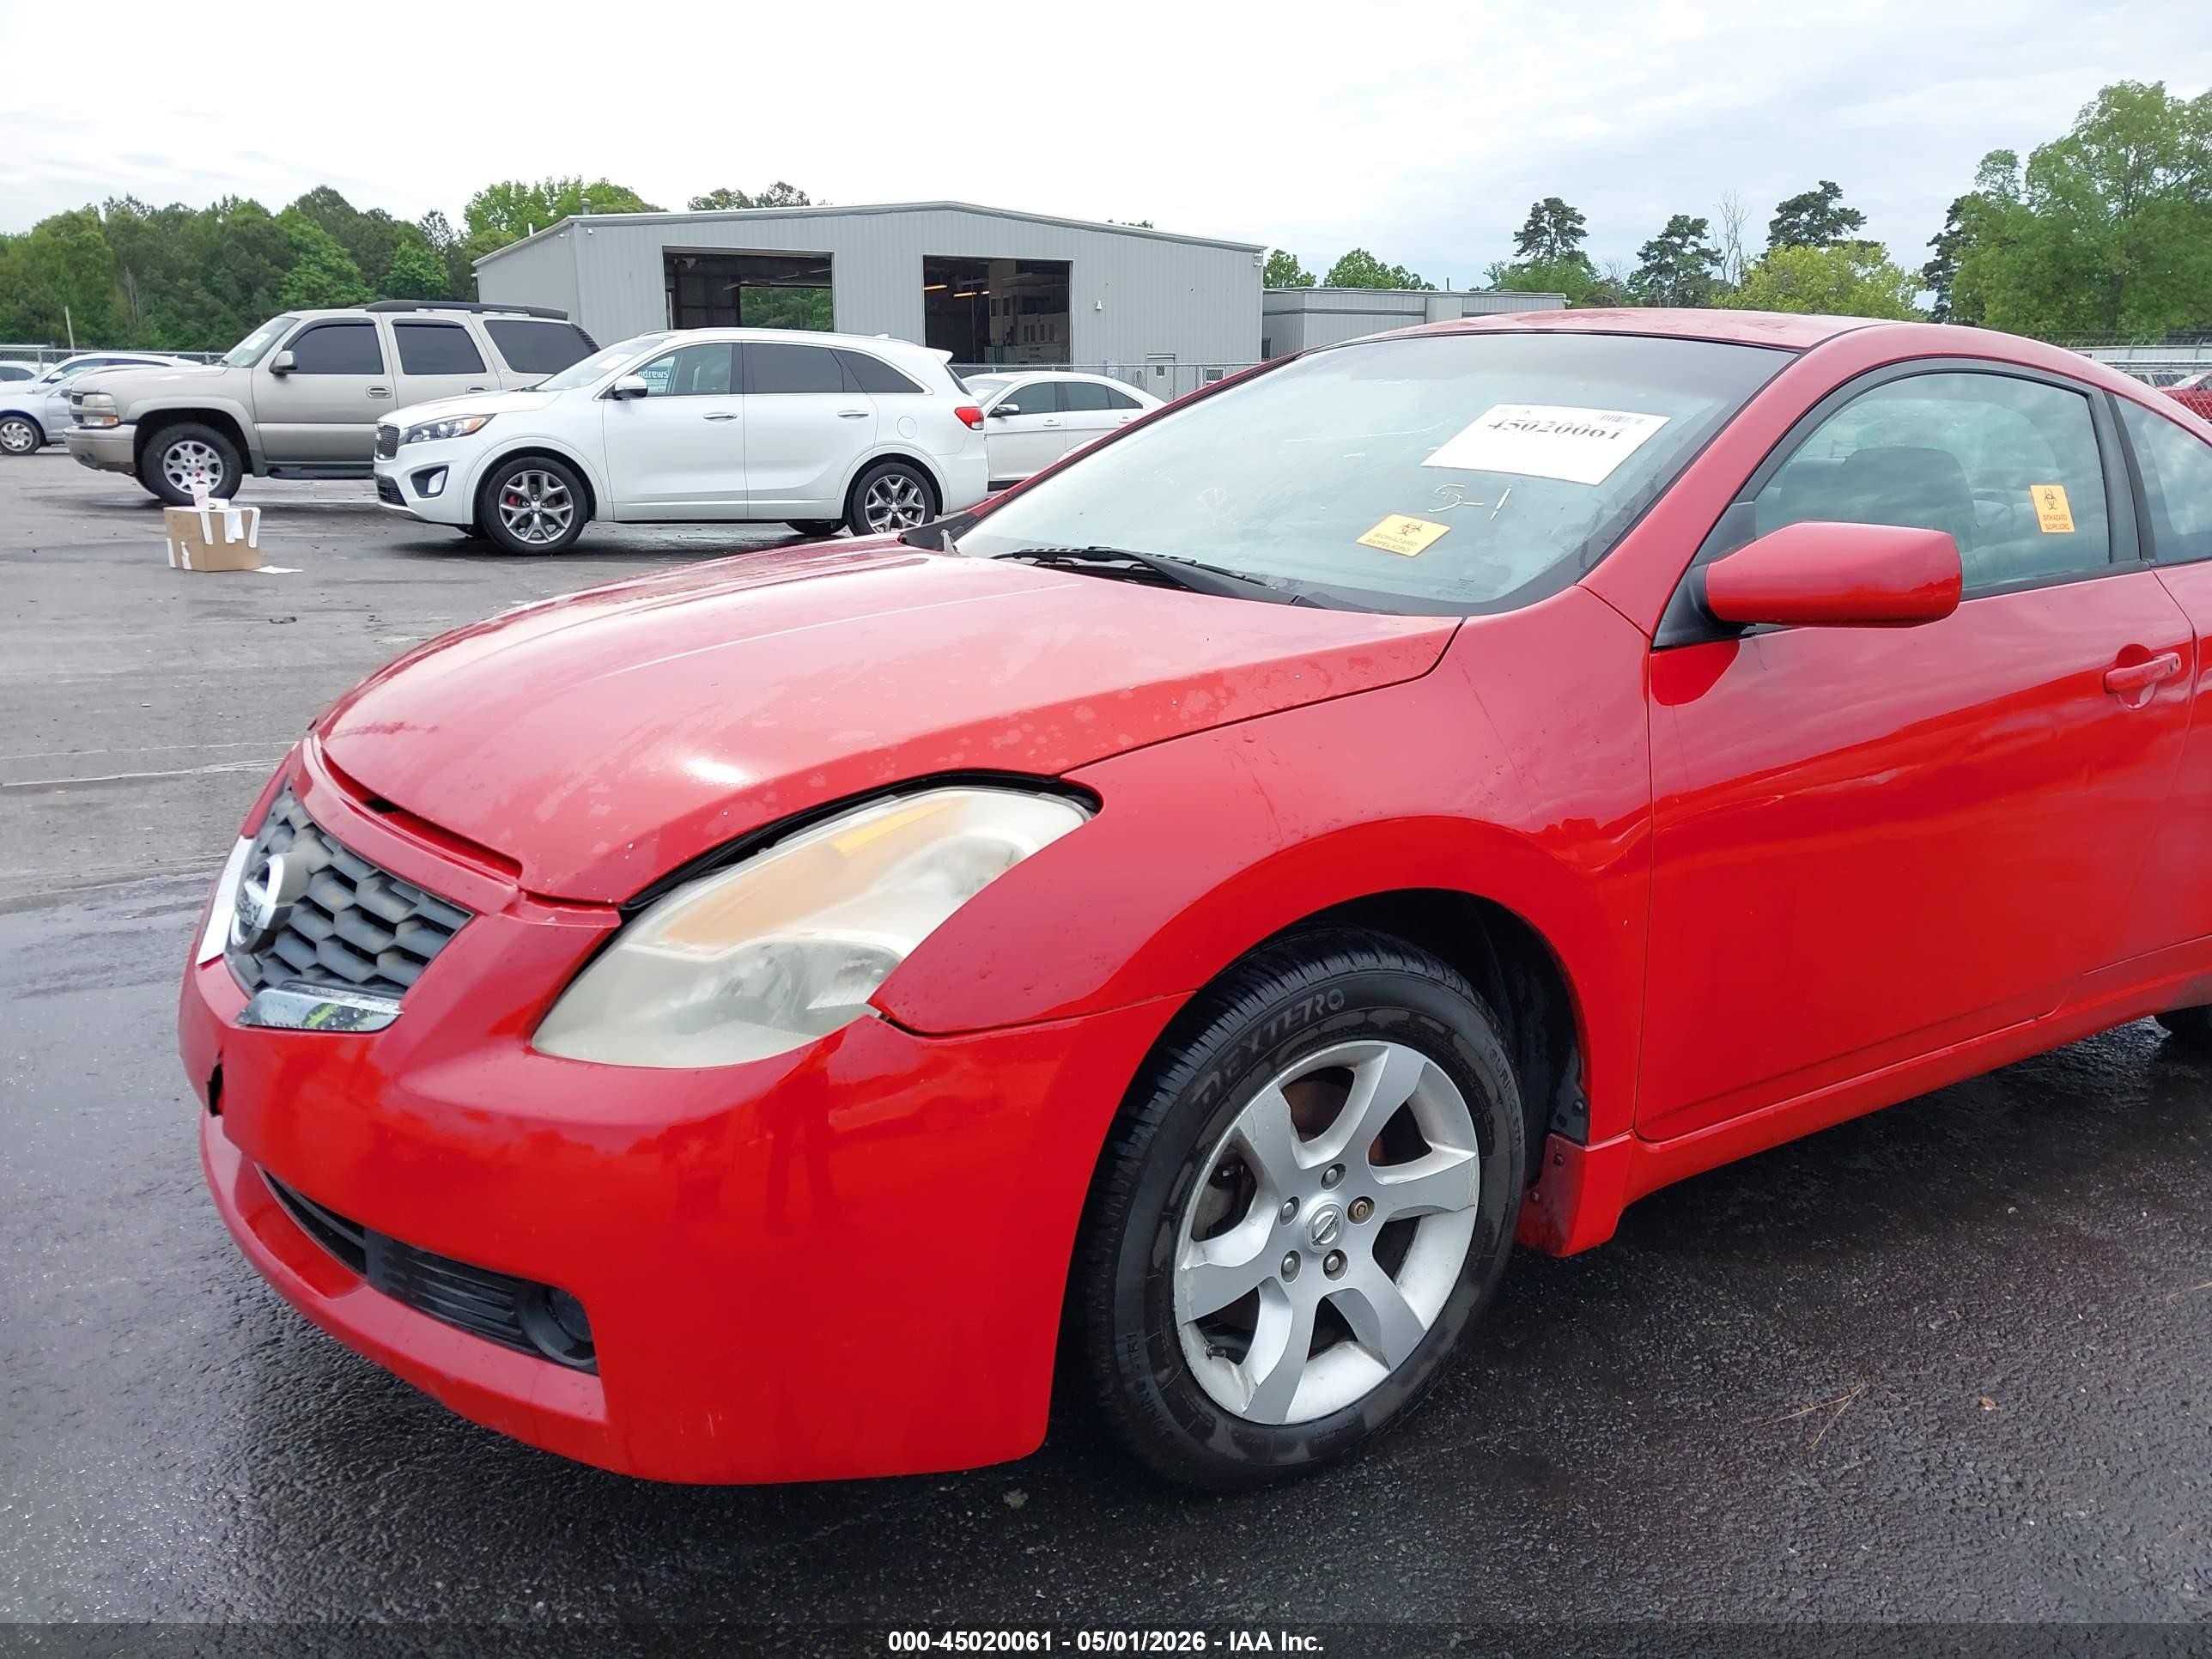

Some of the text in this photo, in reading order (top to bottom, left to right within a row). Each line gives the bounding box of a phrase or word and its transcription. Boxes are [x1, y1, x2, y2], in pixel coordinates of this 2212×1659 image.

[635, 369, 669, 379] ndrews
[1487, 416, 1626, 440] 45020061
[1189, 988, 1346, 1107] DEXTERO
